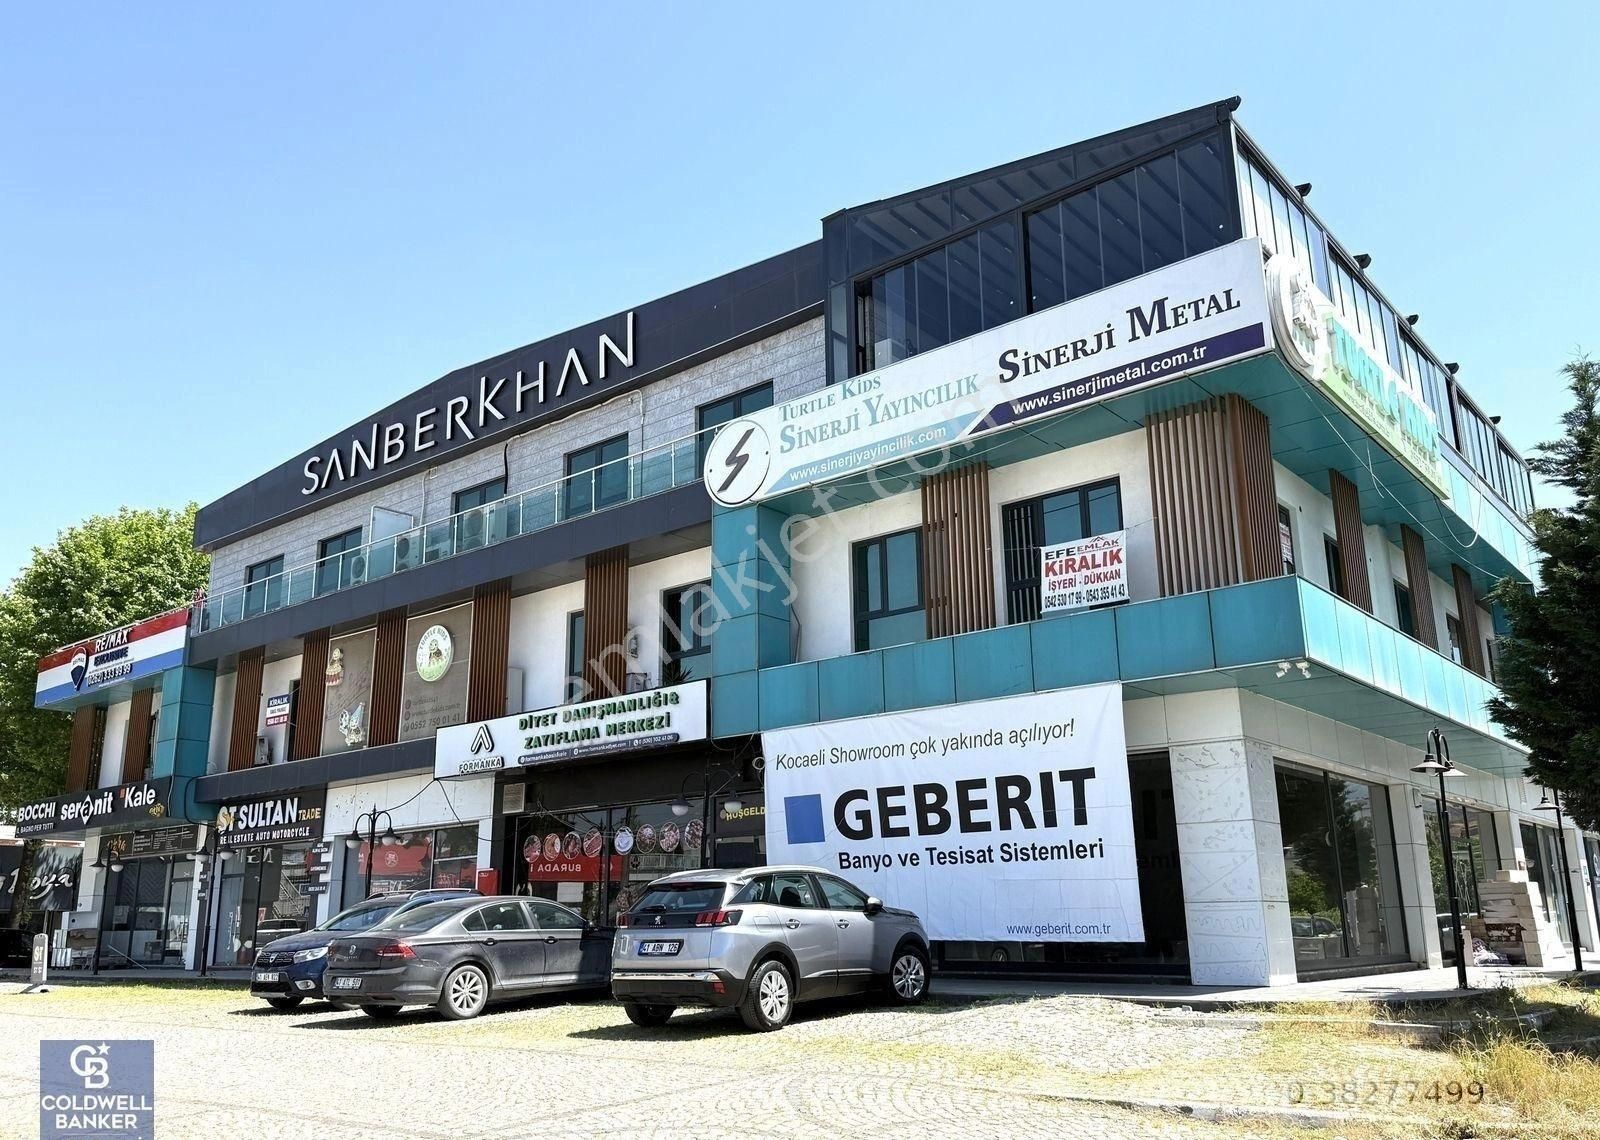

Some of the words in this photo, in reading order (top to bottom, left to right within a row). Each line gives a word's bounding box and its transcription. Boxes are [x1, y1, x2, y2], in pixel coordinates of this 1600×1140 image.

[1126, 288, 1240, 343] METAL
[1012, 344, 1207, 416] www.sinerjimetal.com.tr
[301, 312, 634, 495] SANBERKHAN
[779, 393, 836, 422] TURTLE
[862, 374, 980, 427] YAYINCILIK
[790, 426, 946, 482] www.sinerjiyayincilik.com
[1045, 547, 1076, 560] EFE
[1077, 539, 1119, 552] EMLAK
[1049, 575, 1077, 593] İŞYERİ
[1084, 569, 1121, 585] DÜKKAN
[1058, 593, 1067, 607] 530
[1068, 592, 1075, 605] 17
[1110, 585, 1118, 599] 41
[95, 630, 130, 652] RE/MAX
[410, 720, 426, 730] 0552
[519, 712, 557, 730] DİYET
[524, 725, 600, 750] ZAYIFLAMA
[606, 711, 671, 737] MERKEZİ
[775, 751, 826, 771] Kocaeli
[829, 743, 905, 765] Showroom
[910, 737, 937, 760] çok
[941, 728, 1003, 757] yakında
[1009, 718, 1075, 748] açılıyor!
[459, 757, 502, 773] FORMANKA
[18, 802, 56, 822] BOCCHI
[124, 784, 156, 808] Kale
[238, 797, 298, 829] SULTAN
[298, 807, 321, 822] TRADE
[833, 767, 1096, 841] GEBERIT
[234, 832, 254, 844] ESTATE
[256, 830, 270, 842] AUTO
[272, 827, 310, 840] MOTORCYCLE
[839, 851, 893, 873] Banyo
[897, 853, 920, 867] ve
[925, 843, 994, 865] Tesisat
[1000, 837, 1105, 863] Sistemleri
[1007, 921, 1111, 936] www.geberit.com.tr
